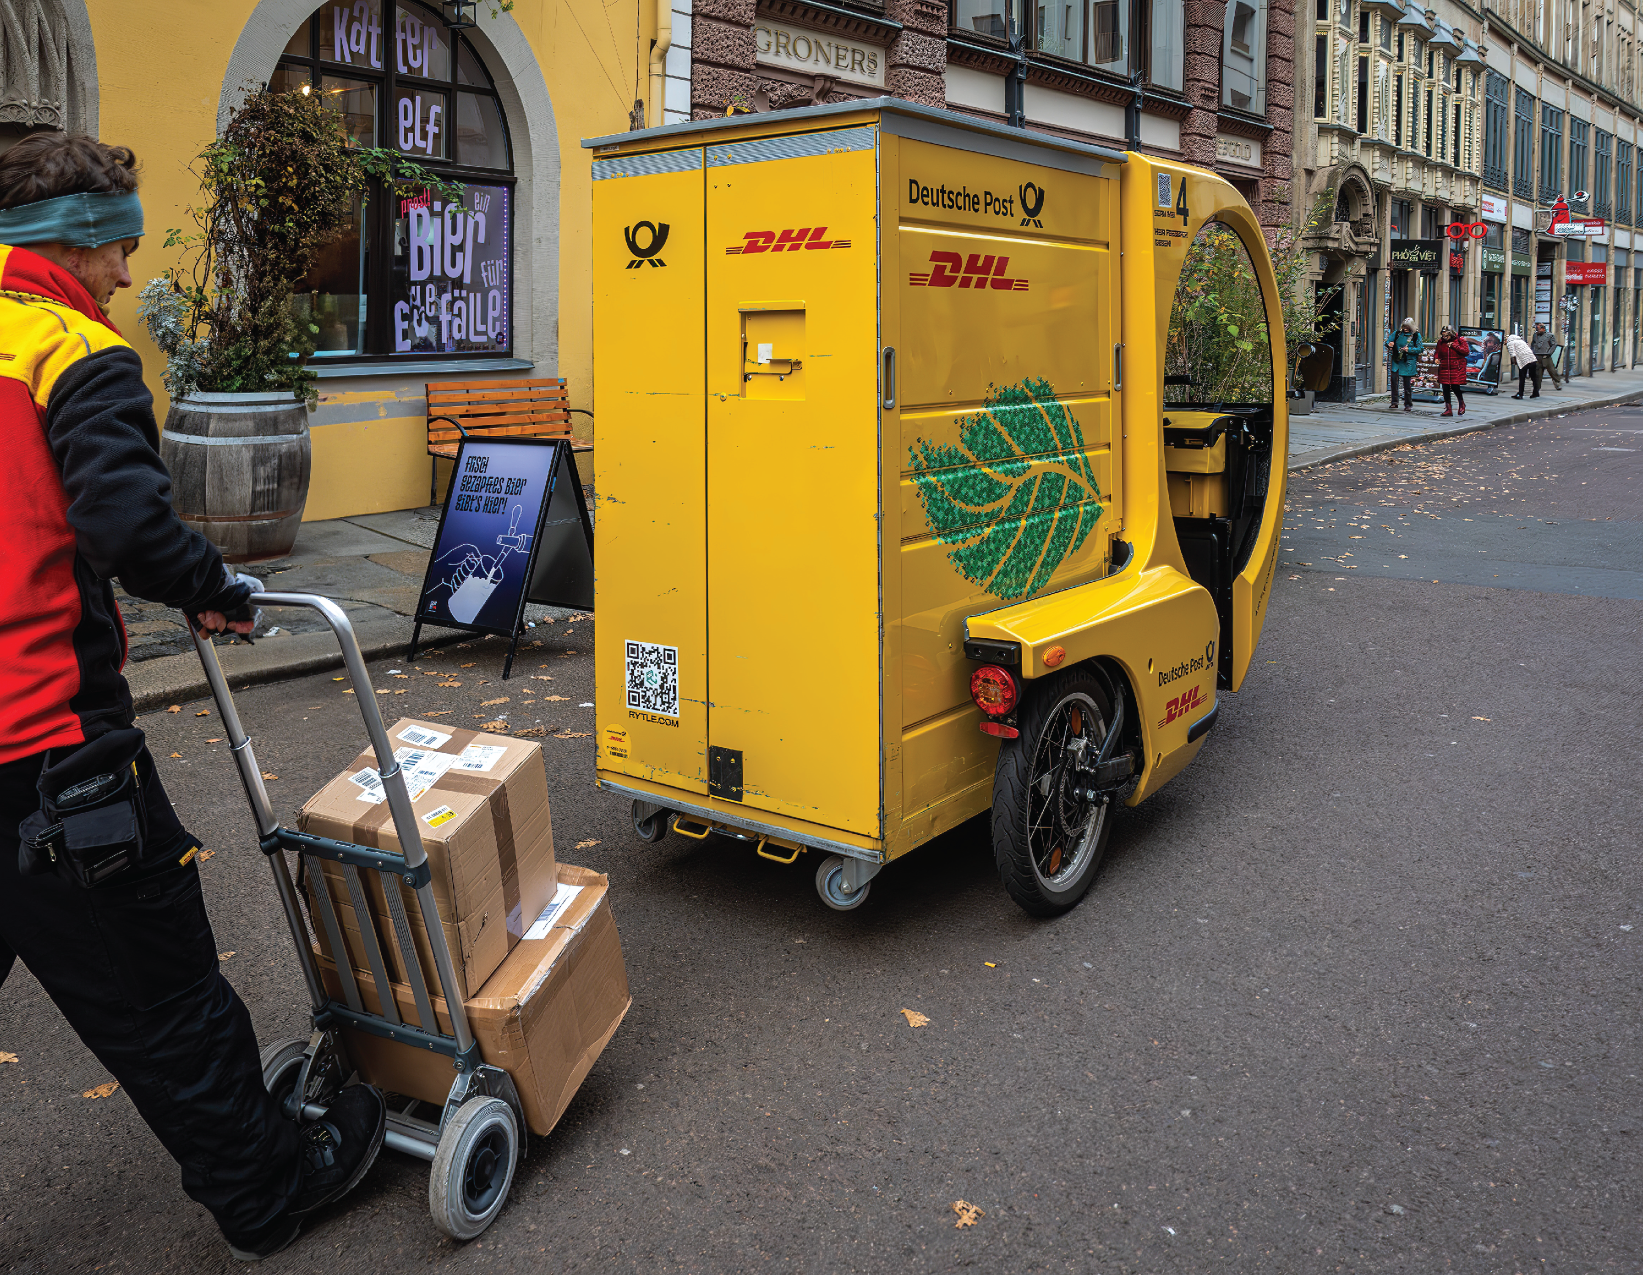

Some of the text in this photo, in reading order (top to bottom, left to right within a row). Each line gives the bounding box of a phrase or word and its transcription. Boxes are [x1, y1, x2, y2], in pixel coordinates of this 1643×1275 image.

[474, 191, 491, 214] ein
[908, 178, 1015, 218] Deutsche Post
[1176, 176, 1190, 227] 4
[409, 200, 487, 285] Bier
[741, 226, 835, 254] DHL
[480, 259, 504, 288] für
[927, 250, 1017, 291] DHL
[1158, 655, 1204, 688] Deutsche Post
[628, 710, 680, 728] RYTLE.COM
[1165, 684, 1201, 726] DHL
